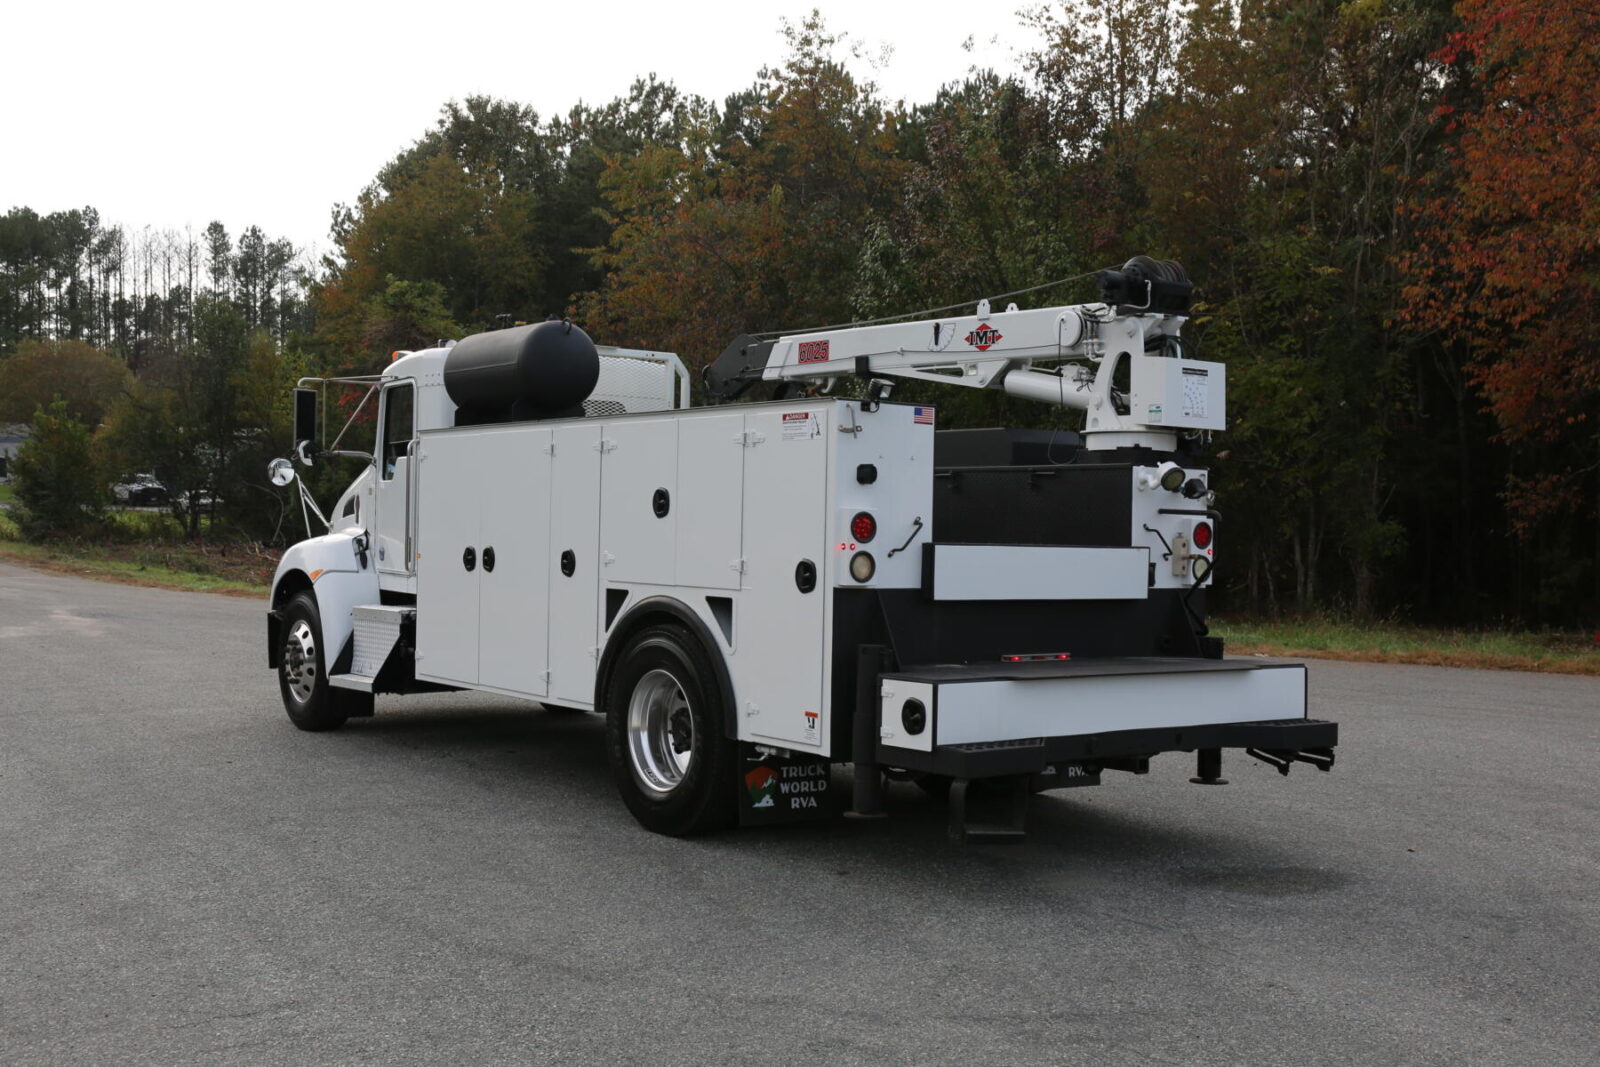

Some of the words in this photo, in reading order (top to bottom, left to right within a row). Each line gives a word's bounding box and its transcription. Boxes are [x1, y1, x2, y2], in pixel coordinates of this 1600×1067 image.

[970, 330, 998, 345] IMT
[800, 341, 828, 361] 6025
[781, 764, 825, 778] TRUCK
[780, 780, 827, 794] WORLD
[791, 796, 817, 809] RVA
